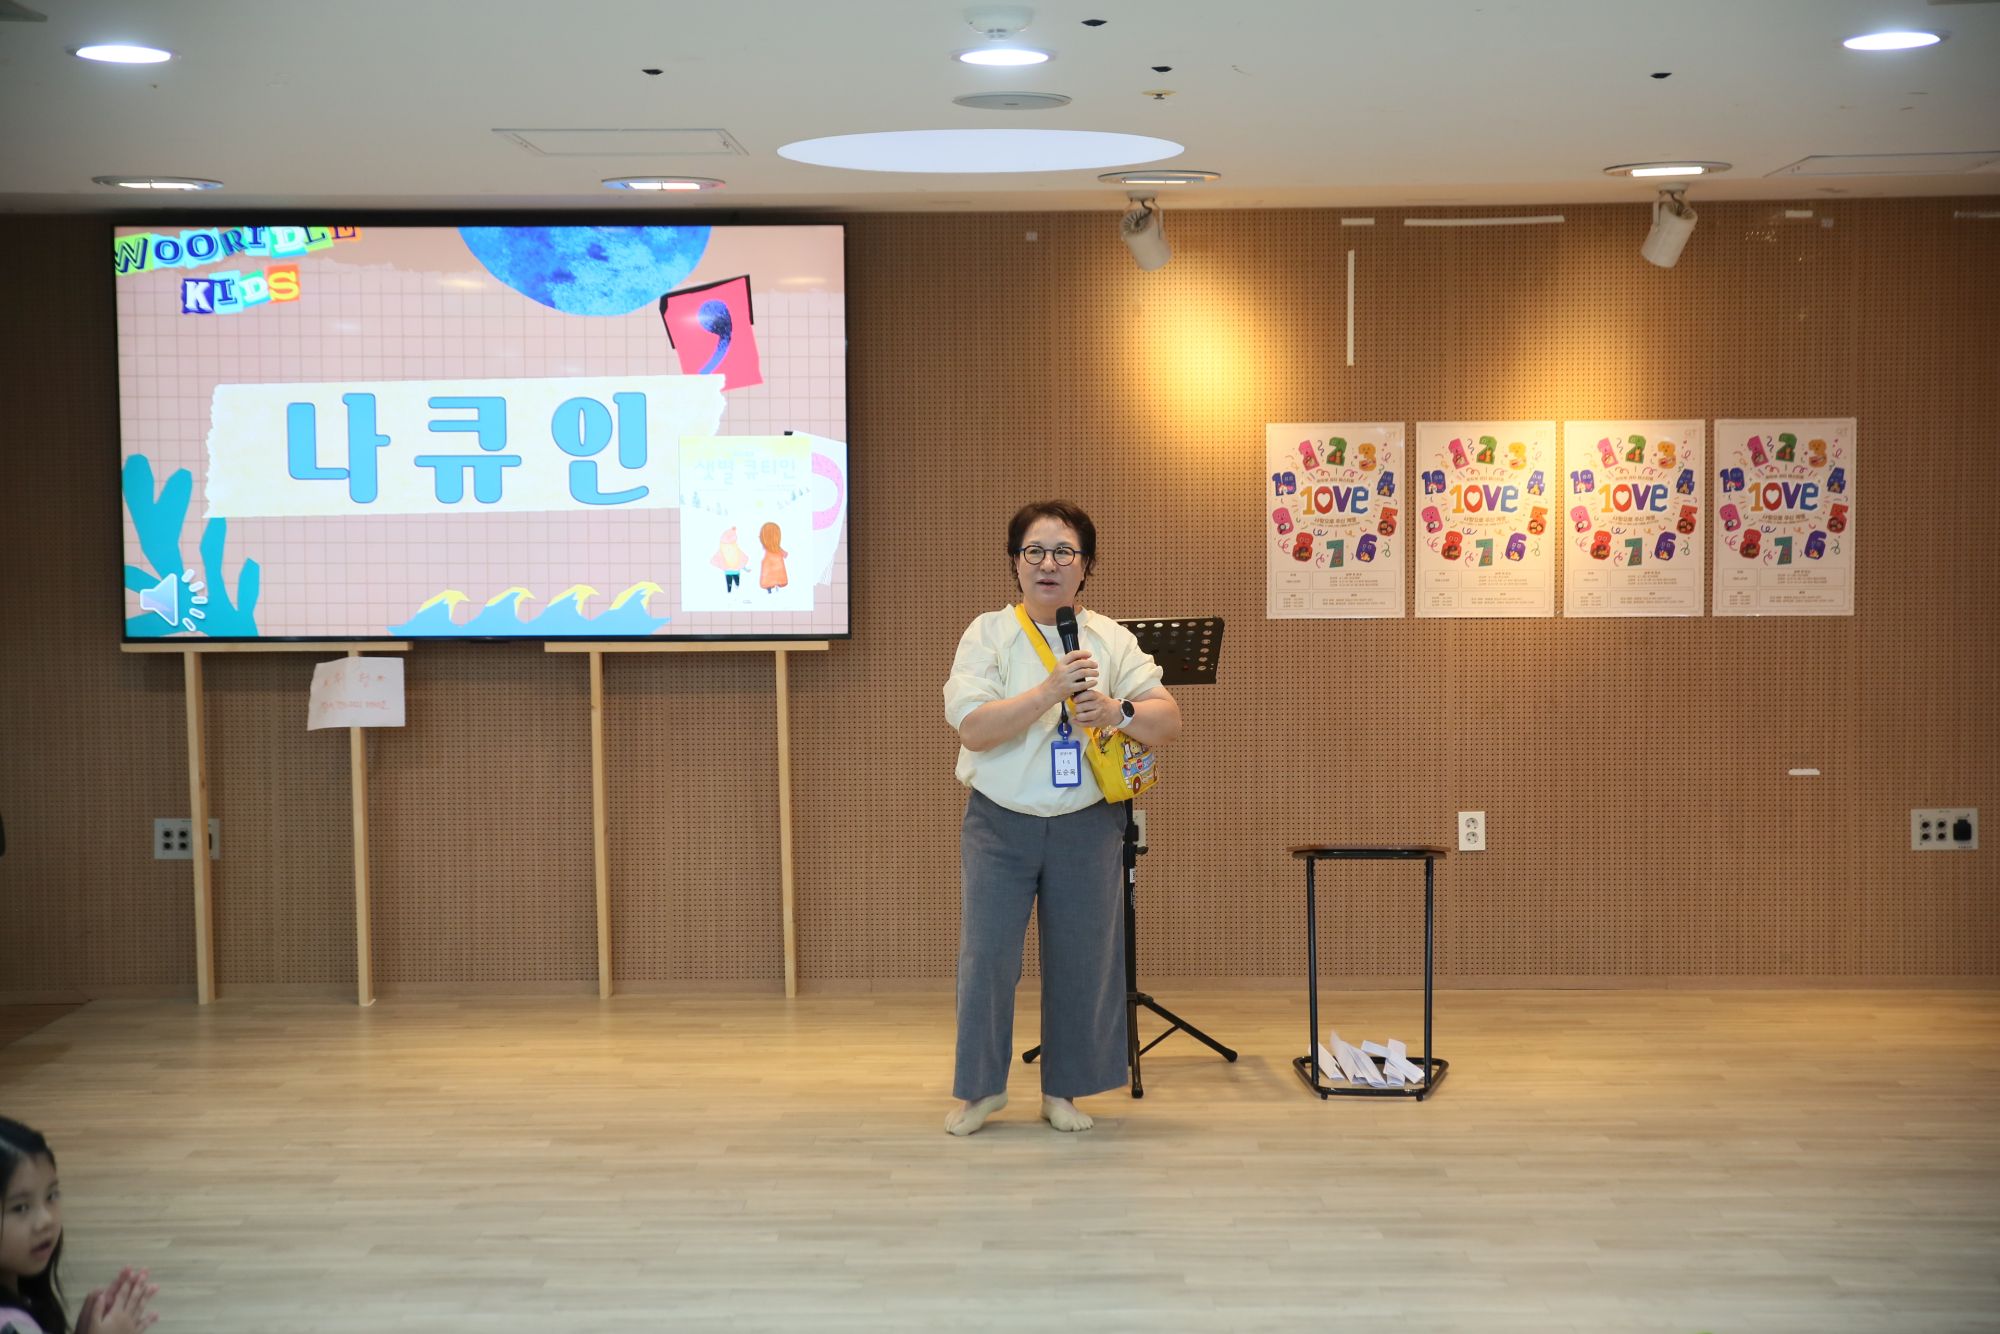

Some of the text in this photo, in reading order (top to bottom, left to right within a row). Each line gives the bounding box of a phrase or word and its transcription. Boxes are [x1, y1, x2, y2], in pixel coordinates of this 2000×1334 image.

[184, 271, 299, 311] KIDS
[1298, 440, 1320, 471] 1
[1326, 437, 1347, 466] 2
[1358, 443, 1376, 471] 3
[1448, 438, 1469, 469] 1
[1476, 436, 1497, 465] 2
[1508, 442, 1526, 470] 3
[1597, 438, 1618, 468] 1
[1626, 435, 1646, 464] 2
[1657, 441, 1676, 468] 3
[1747, 436, 1769, 467] 1
[1776, 433, 1797, 462] 2
[1808, 439, 1827, 467] 3
[1376, 471, 1395, 497] 4
[1527, 470, 1545, 496] 4
[1676, 469, 1695, 495] 4
[1827, 467, 1846, 494] 4
[1272, 507, 1294, 535] 9
[1377, 507, 1398, 537] 5
[1421, 506, 1443, 534] 9
[1527, 506, 1548, 535] 5
[1570, 506, 1592, 533] 9
[1676, 505, 1698, 535] 5
[1719, 504, 1741, 532] 9
[1827, 503, 1848, 533] 5
[1292, 532, 1313, 562] 8
[1326, 540, 1344, 568] 7
[1356, 533, 1377, 563] 6
[1441, 531, 1463, 561] 8
[1476, 539, 1493, 567] 7
[1505, 532, 1527, 562] 6
[1590, 530, 1612, 560] 8
[1625, 538, 1642, 566] 7
[1654, 531, 1676, 561] 6
[1739, 529, 1761, 559] 8
[1775, 536, 1792, 565] 7
[1804, 530, 1827, 560] 6
